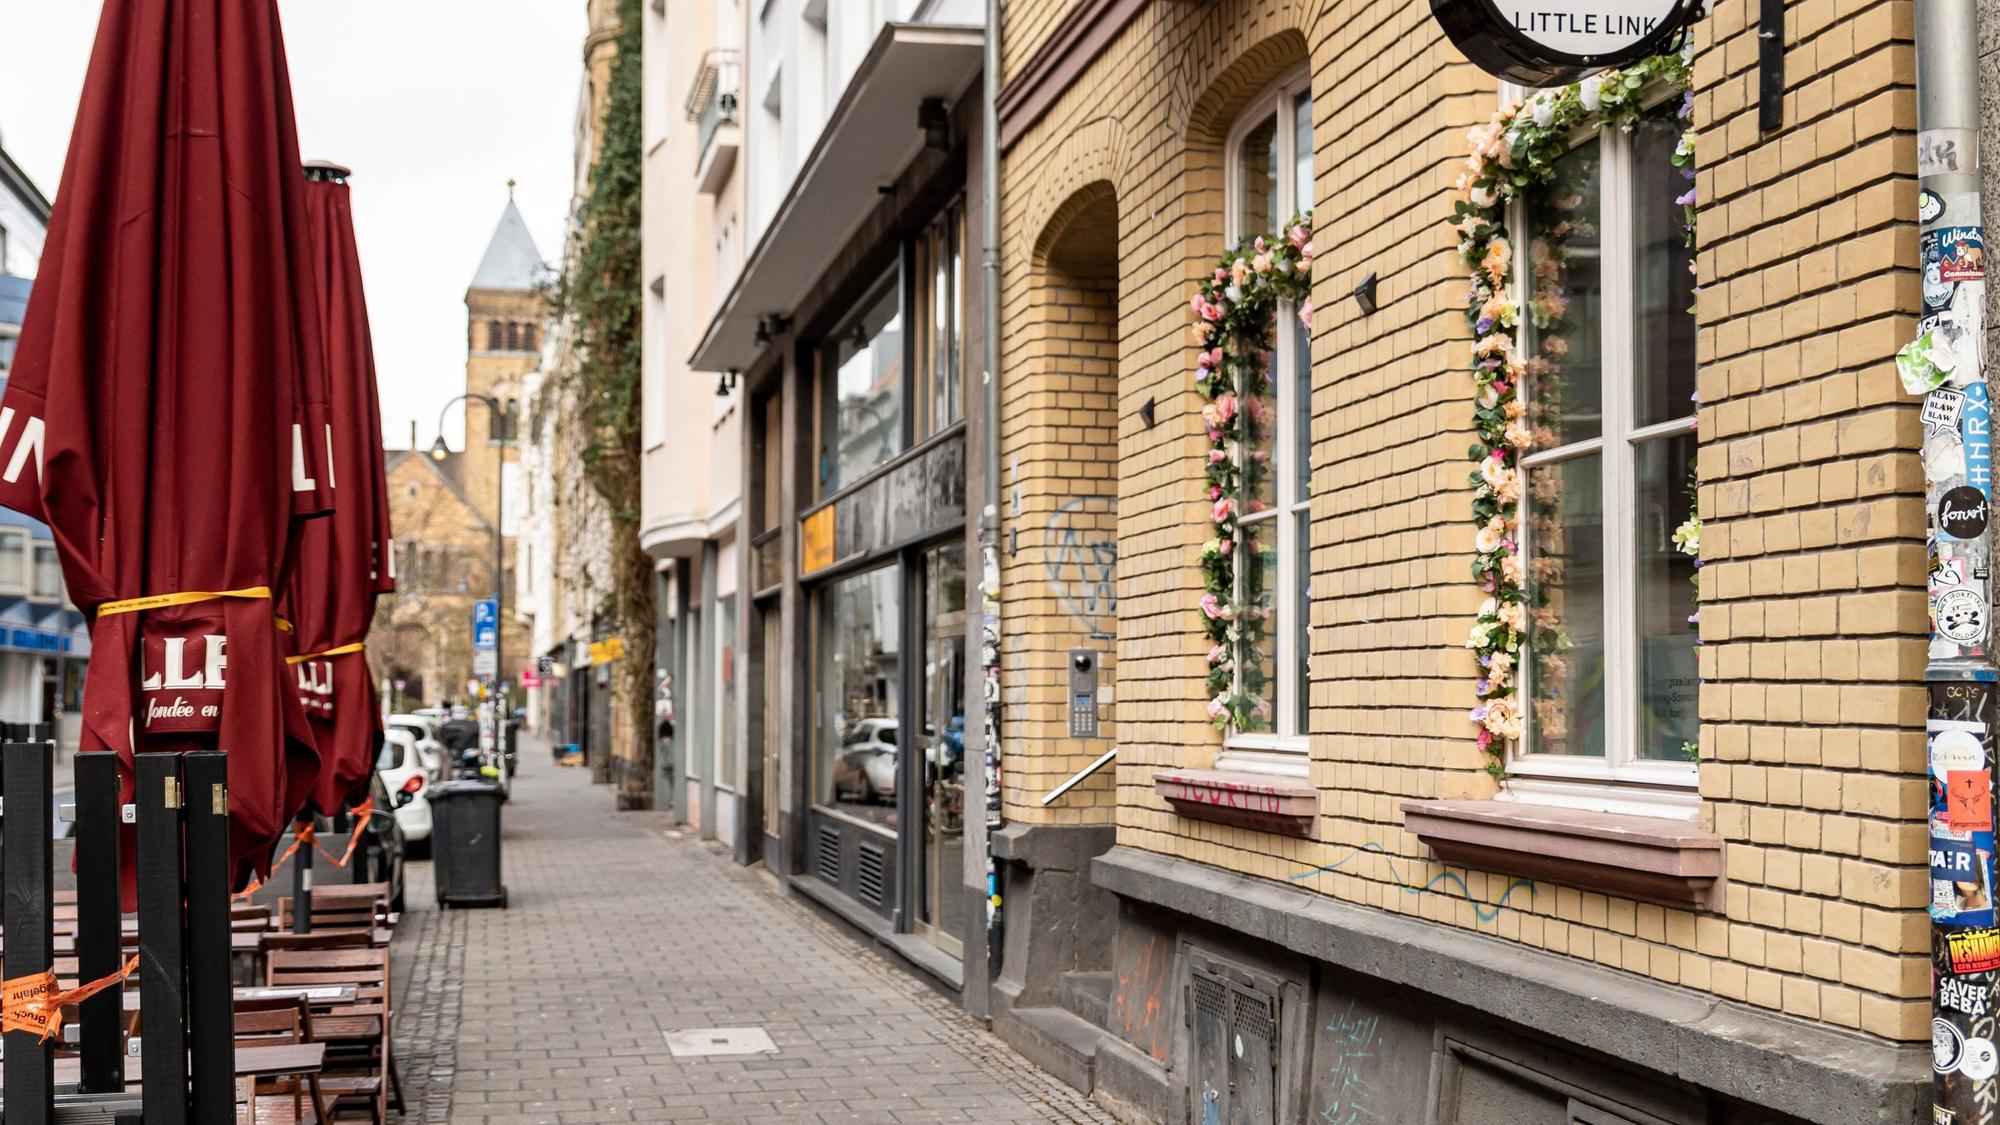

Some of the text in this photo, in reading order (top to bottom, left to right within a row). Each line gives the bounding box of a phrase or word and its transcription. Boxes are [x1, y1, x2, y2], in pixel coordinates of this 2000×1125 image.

[1515, 12, 1658, 36] LITTLE LINK
[1929, 401, 1956, 413] BLAW
[145, 696, 219, 729] fondée en
[1940, 976, 1987, 1001] SAVER
[1940, 991, 1986, 1015] BEBA
